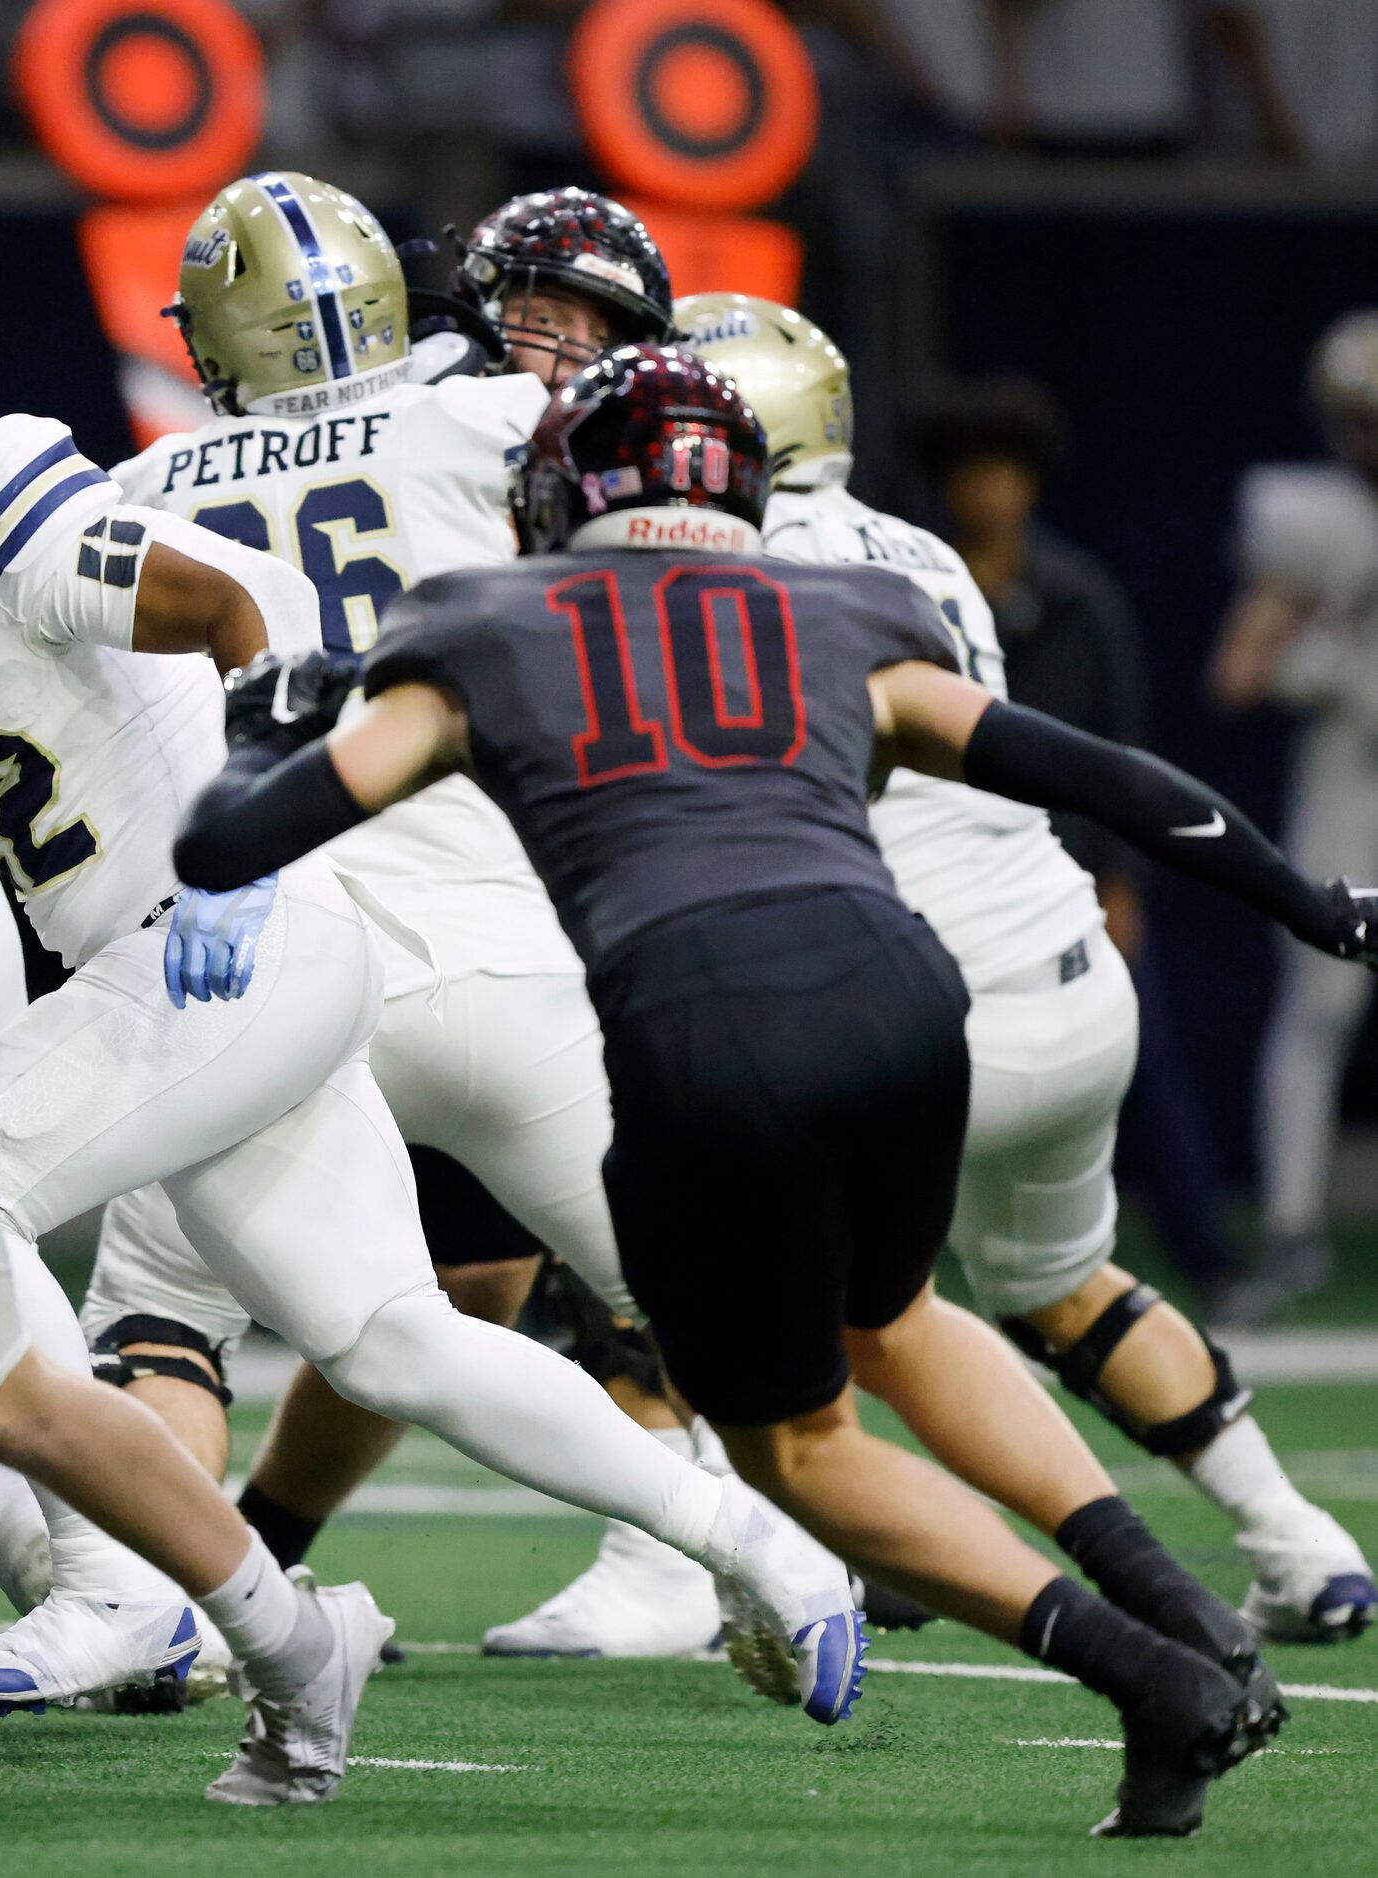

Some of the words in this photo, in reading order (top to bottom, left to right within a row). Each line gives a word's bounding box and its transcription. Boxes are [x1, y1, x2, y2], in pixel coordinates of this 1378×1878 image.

[296, 349, 318, 372] 66
[274, 392, 329, 414] FEAR
[162, 412, 390, 494] PETROFF
[546, 565, 808, 789] 10
